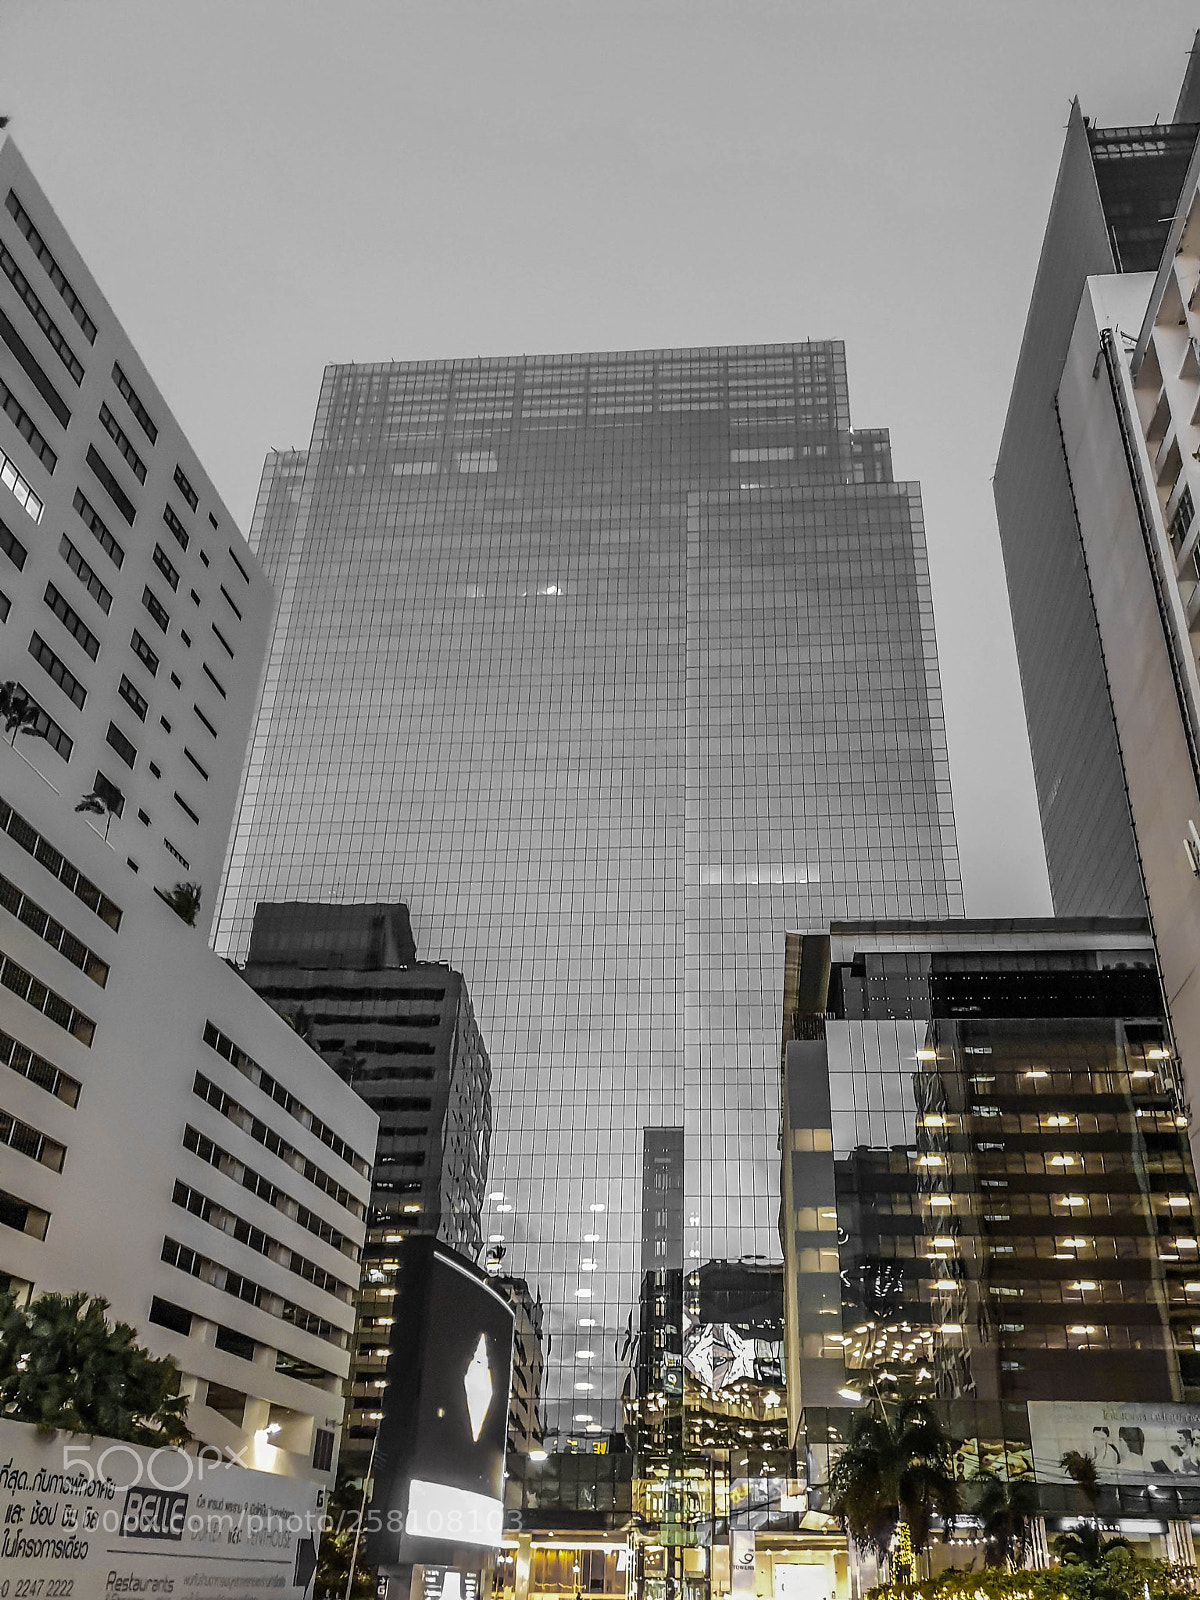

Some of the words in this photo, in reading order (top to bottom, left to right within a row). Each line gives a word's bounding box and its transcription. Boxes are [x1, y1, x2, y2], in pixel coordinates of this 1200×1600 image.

[4, 1504, 25, 1525] และ
[124, 1492, 186, 1535] BELLE
[15, 1579, 44, 1598] 2247
[46, 1579, 74, 1598] 2222
[105, 1570, 175, 1593] Restaurants
